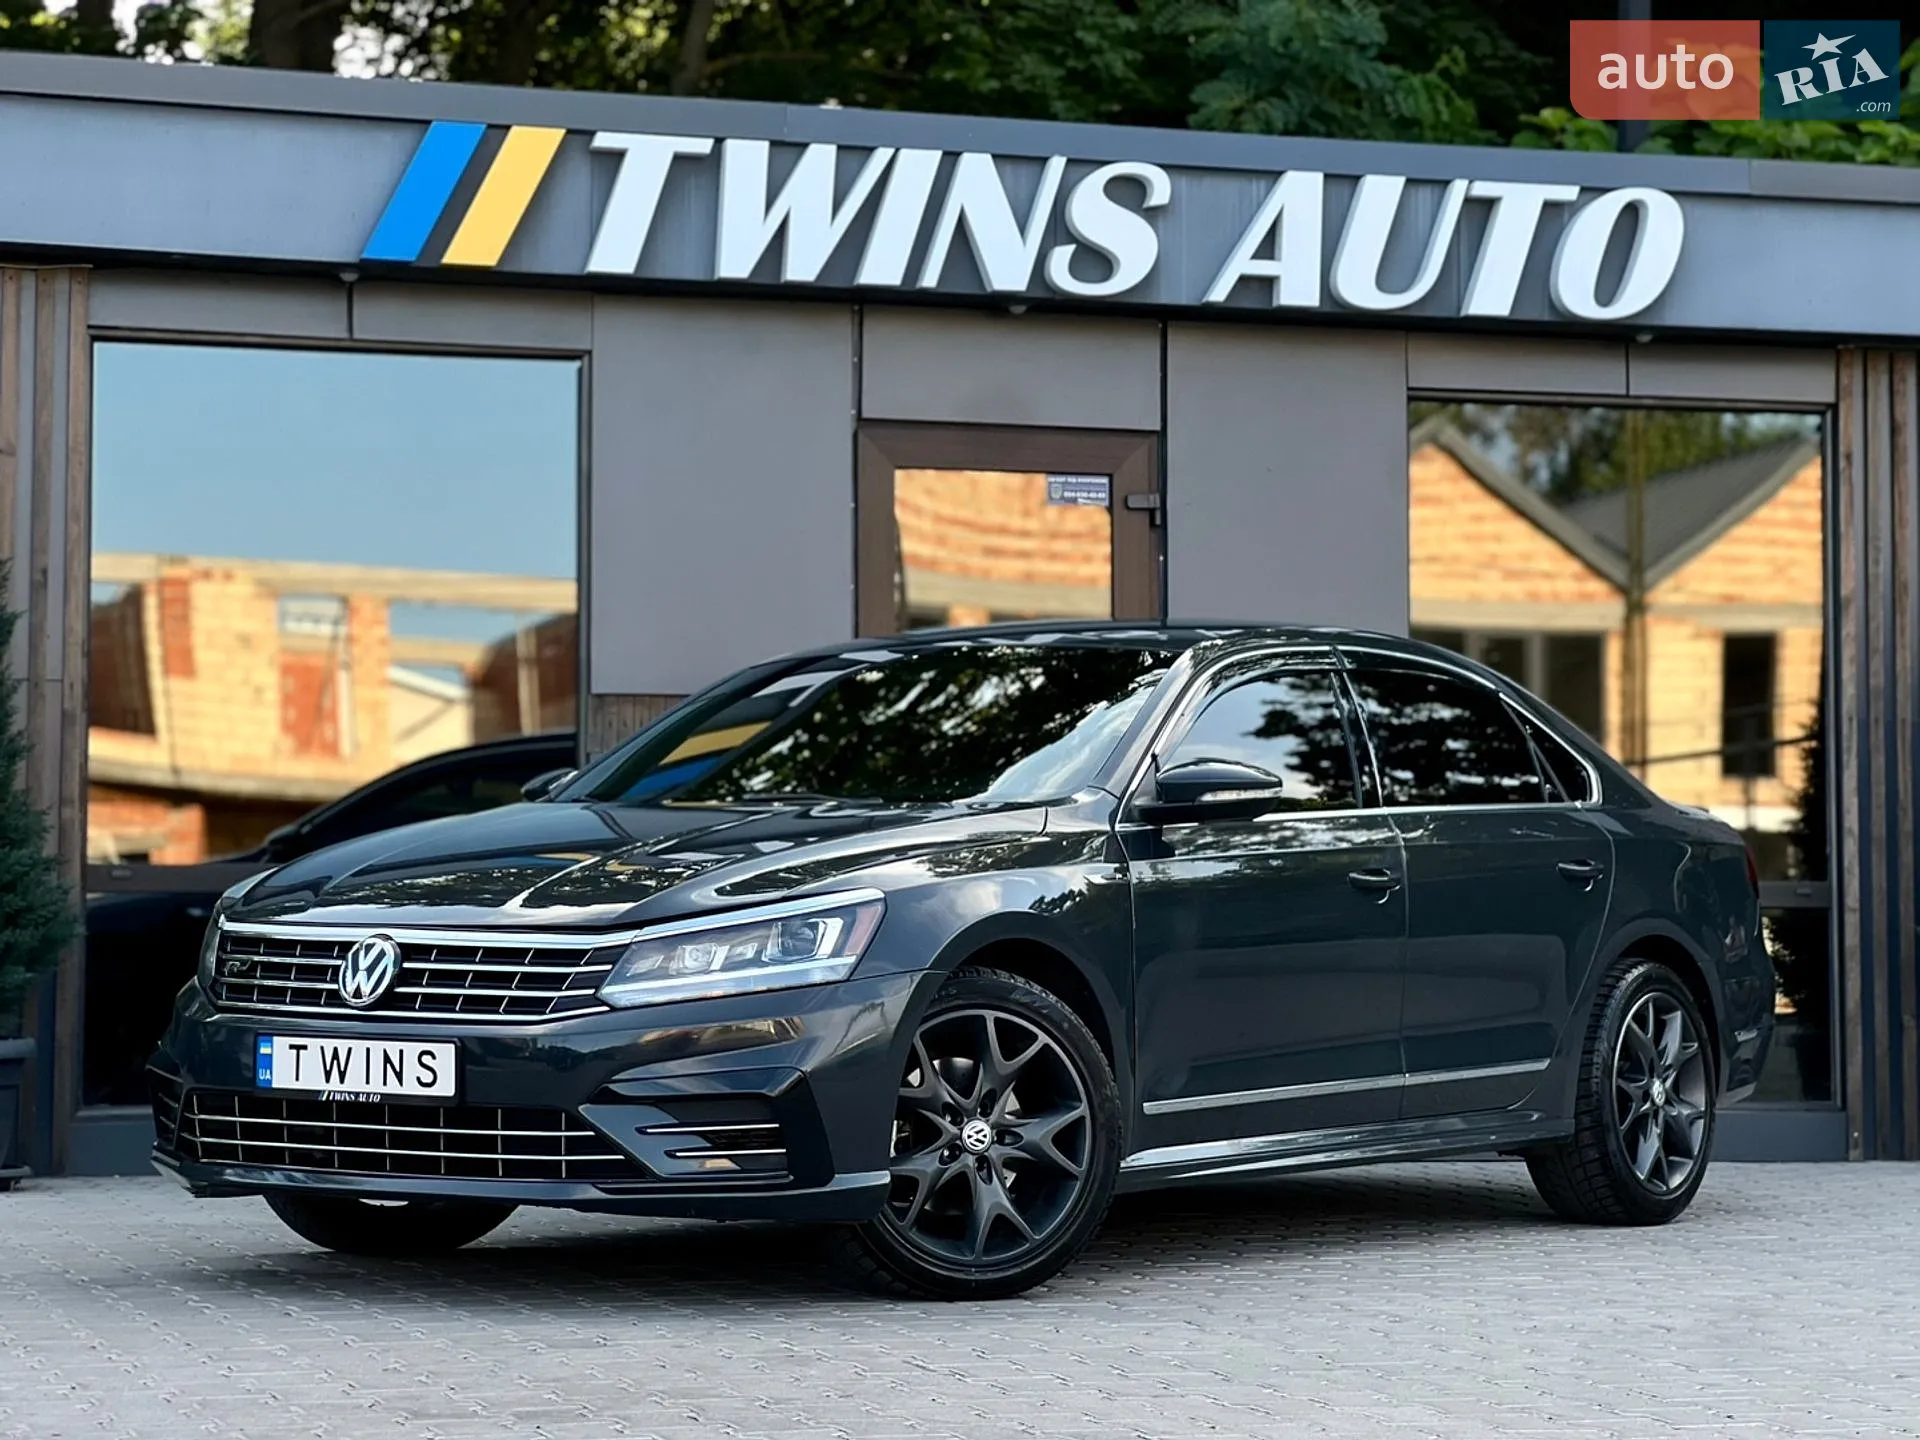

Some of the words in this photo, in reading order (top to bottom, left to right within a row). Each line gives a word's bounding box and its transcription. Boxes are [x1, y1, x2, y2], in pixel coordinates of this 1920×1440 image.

[585, 131, 1172, 297] TWINS
[1202, 169, 1685, 320] AUTO
[259, 1069, 271, 1080] UA
[288, 1043, 438, 1088] TWINS
[358, 1093, 381, 1103] AUTO
